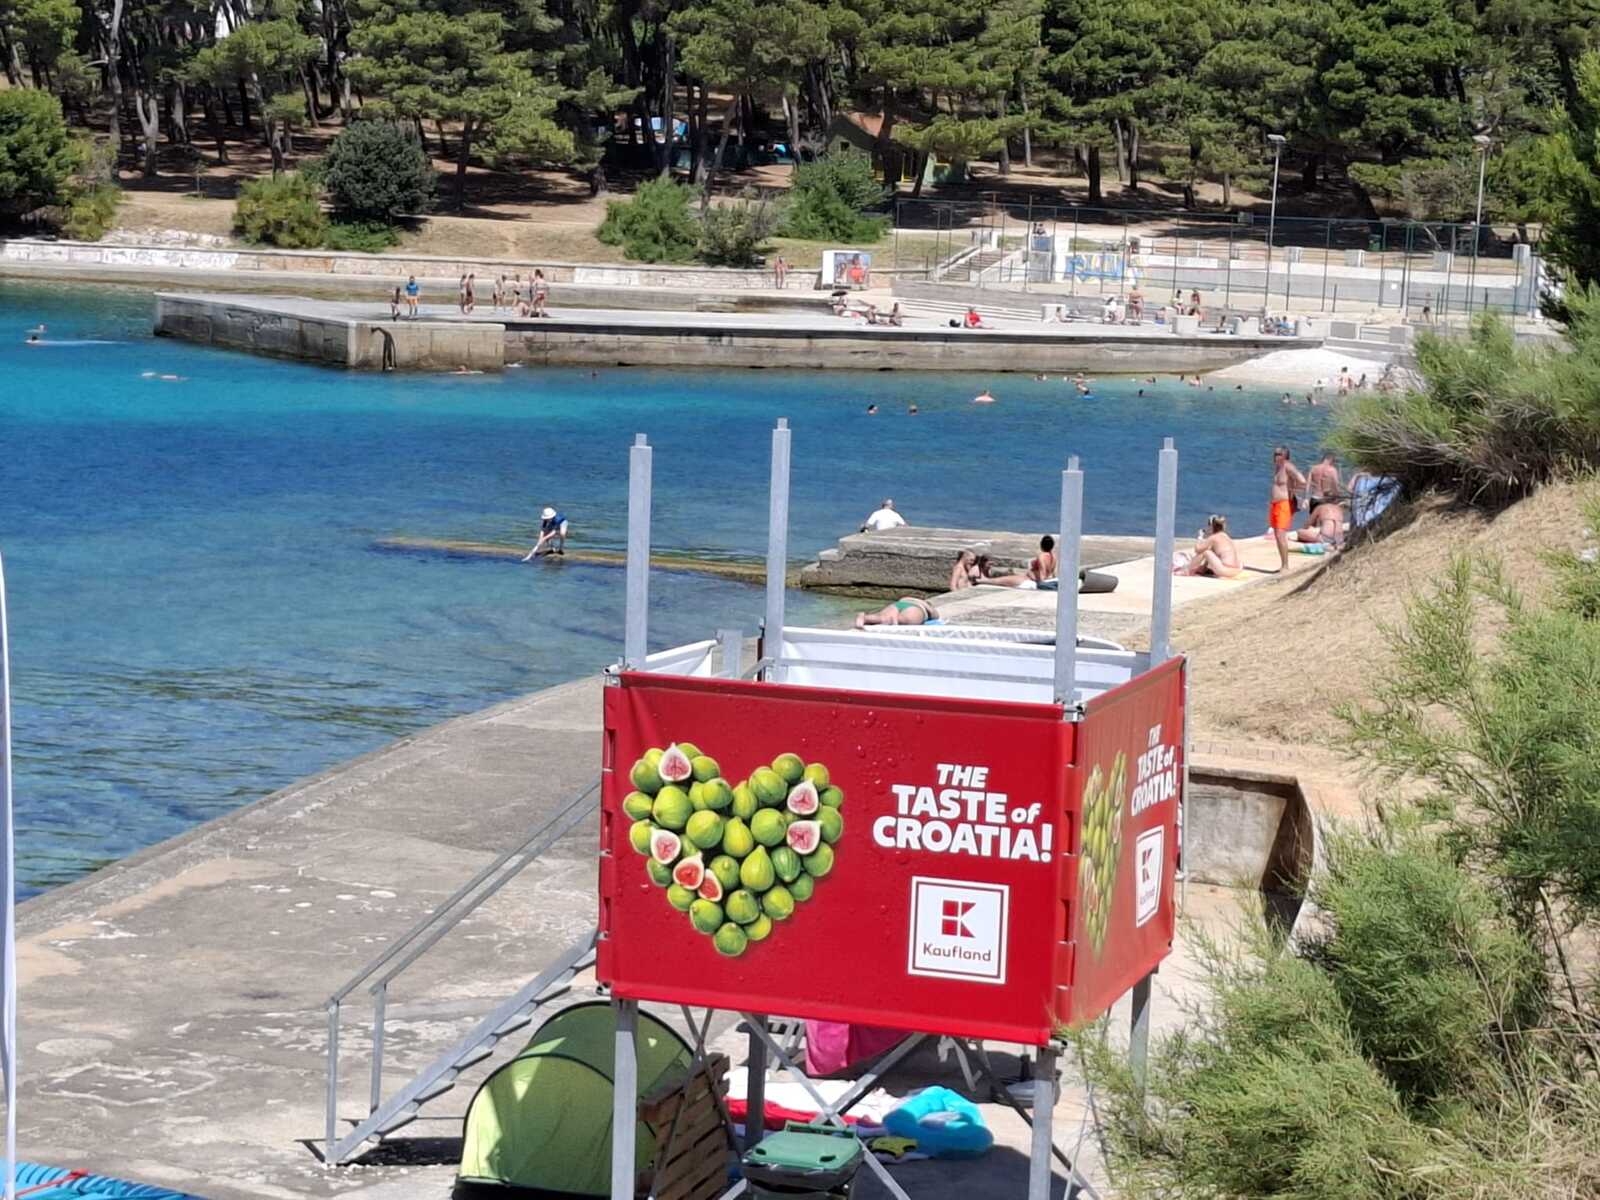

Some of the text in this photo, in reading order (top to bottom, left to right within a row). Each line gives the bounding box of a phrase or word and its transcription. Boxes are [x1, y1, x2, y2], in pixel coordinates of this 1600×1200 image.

[936, 764, 989, 788] THE
[1131, 761, 1177, 816] CROATIA!
[892, 784, 1041, 824] TASTE of
[873, 816, 1052, 863] CROATIA!
[922, 943, 992, 962] Kaufland
